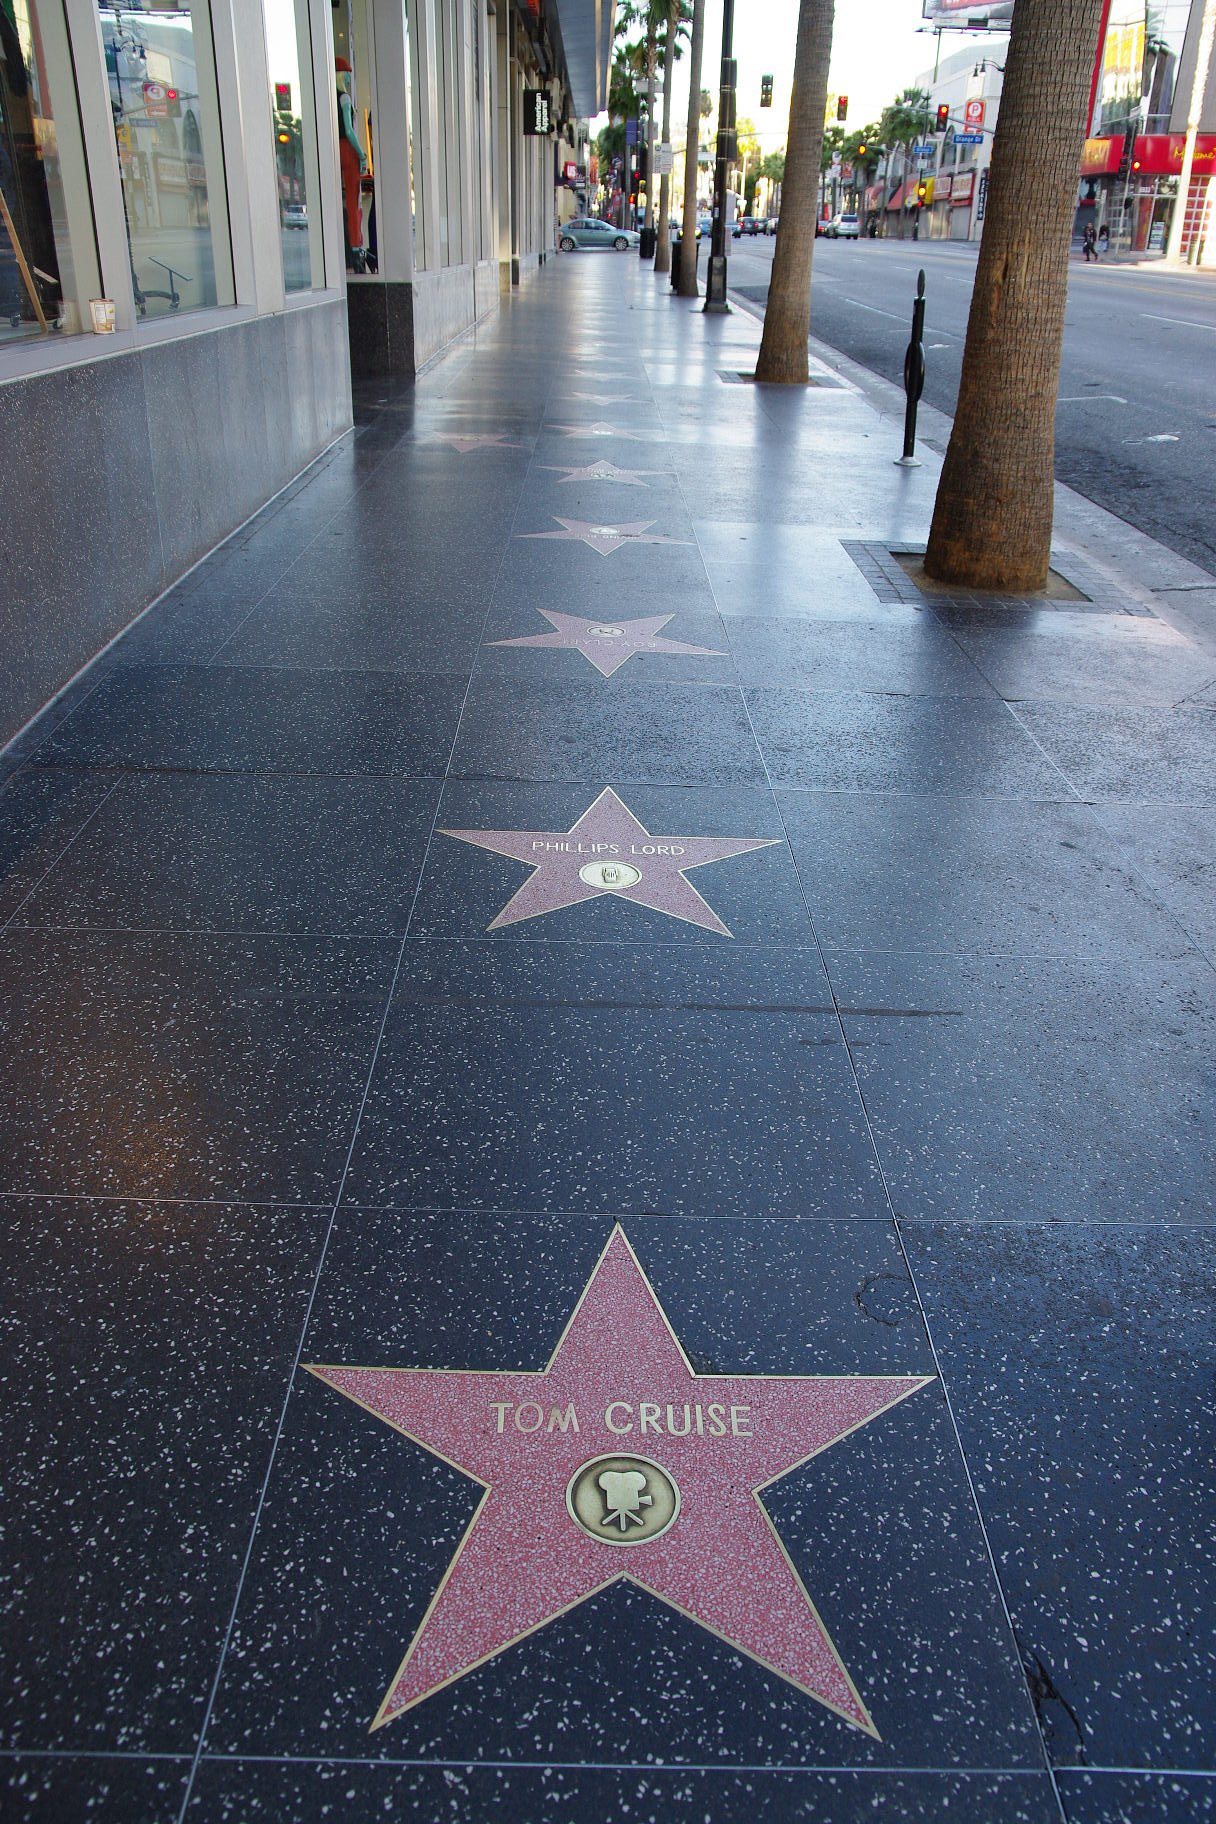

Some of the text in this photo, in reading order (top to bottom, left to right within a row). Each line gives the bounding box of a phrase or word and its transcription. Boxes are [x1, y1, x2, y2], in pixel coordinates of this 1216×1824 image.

[534, 92, 542, 132] American
[541, 100, 549, 132] Apparel
[620, 640, 656, 648] ROY
[531, 841, 685, 856] PHILLIPS LORD
[489, 1402, 754, 1438] TOM CRUISE
